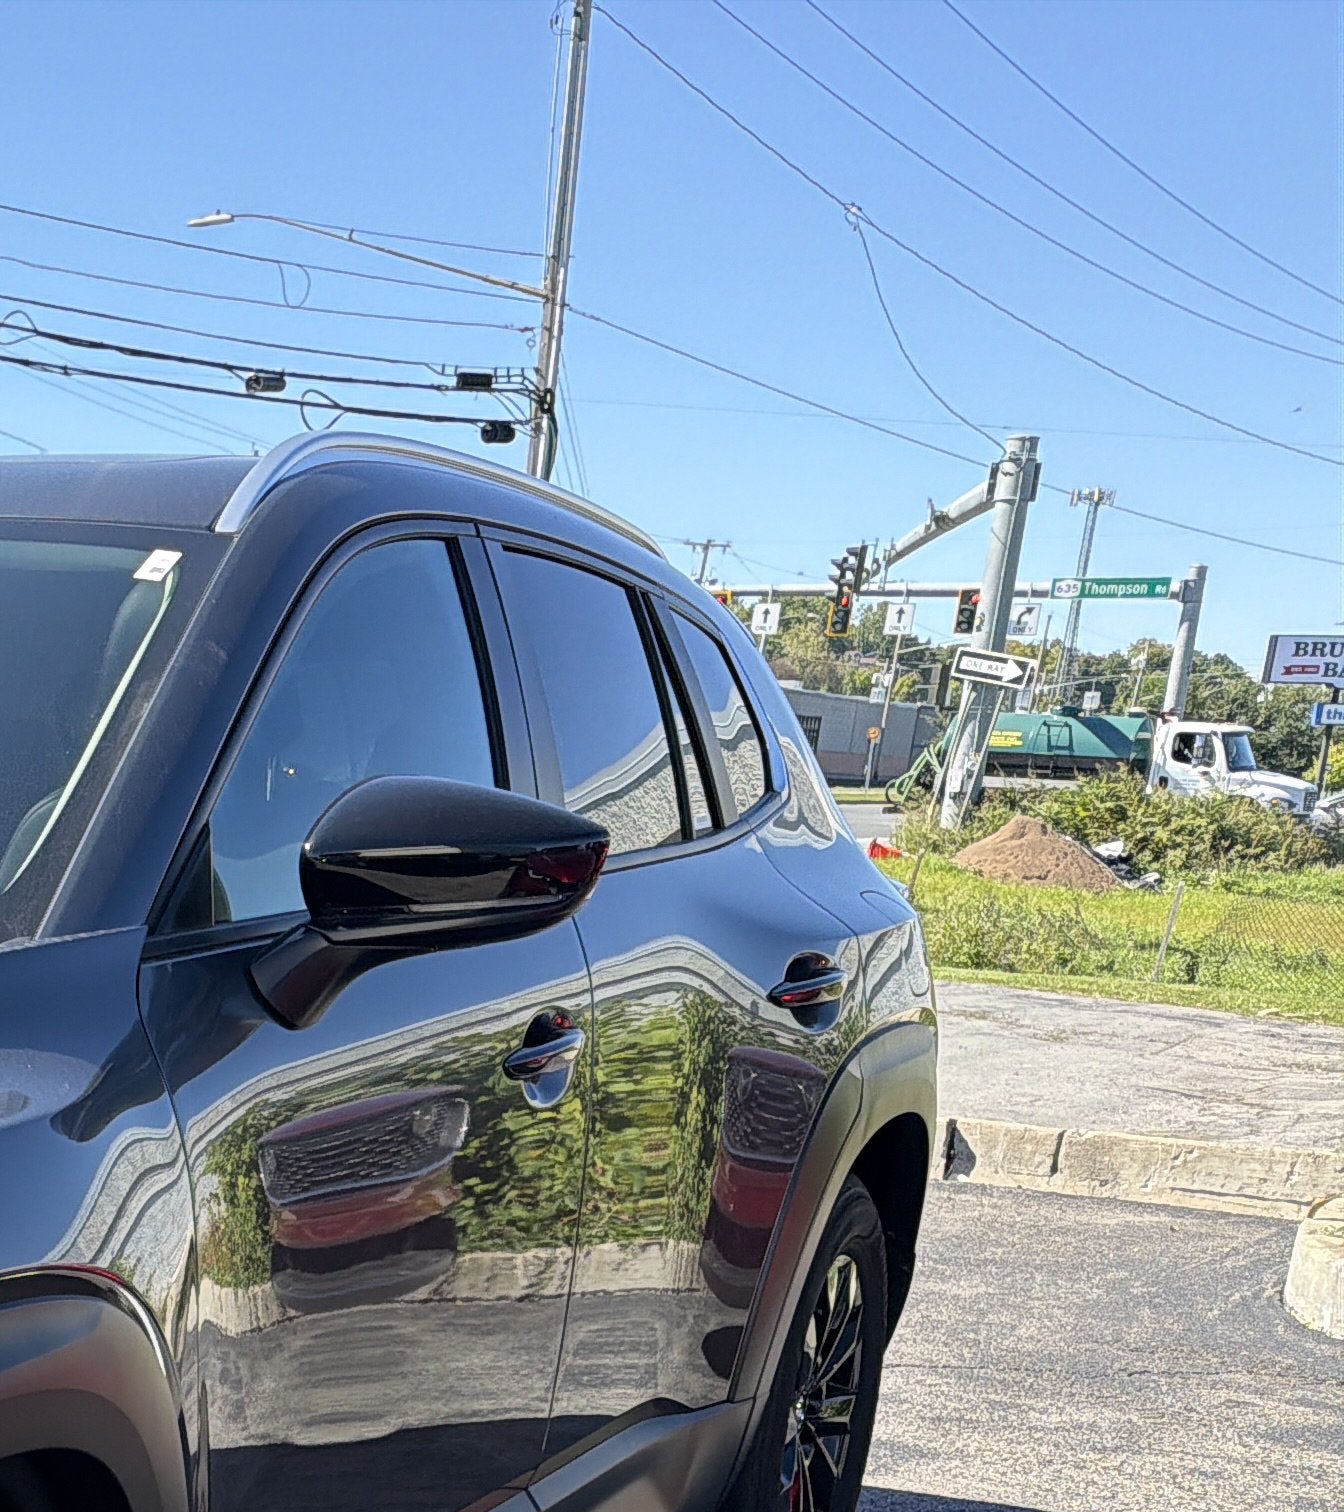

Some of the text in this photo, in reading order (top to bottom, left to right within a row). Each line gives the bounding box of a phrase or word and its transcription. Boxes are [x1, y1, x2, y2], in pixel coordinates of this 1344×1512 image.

[1057, 582, 1168, 597] 635 Thompson Rd
[1326, 708, 1344, 720] th
